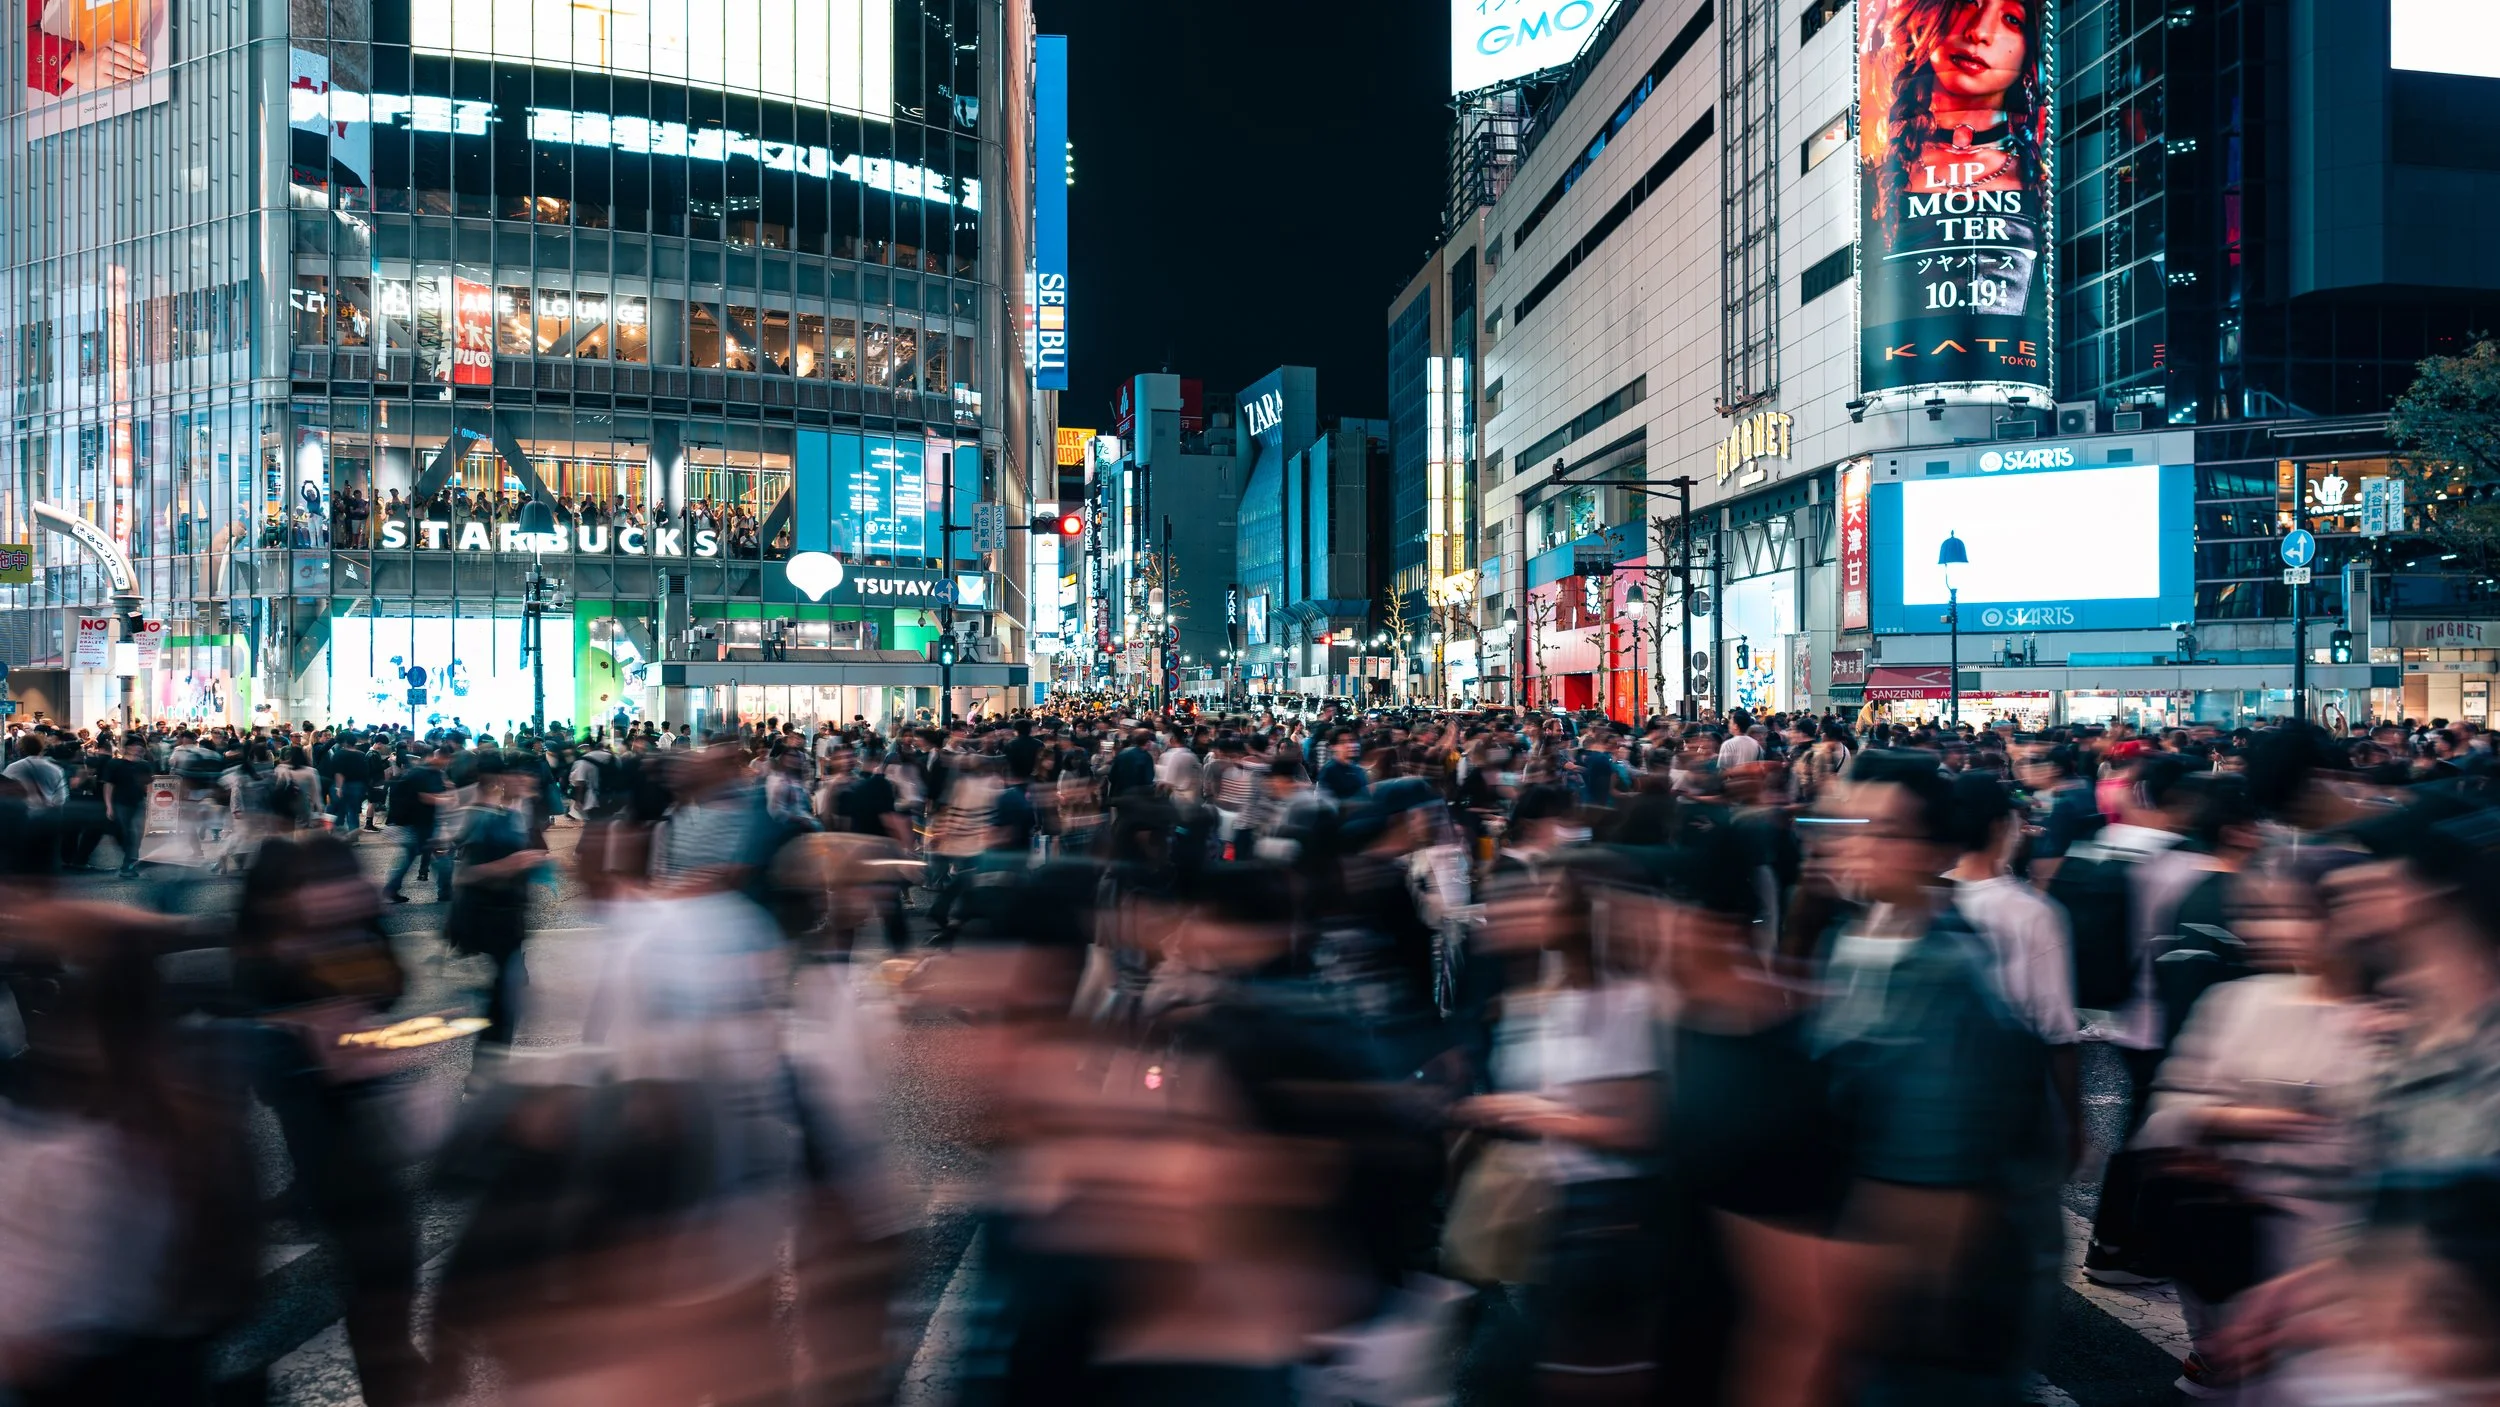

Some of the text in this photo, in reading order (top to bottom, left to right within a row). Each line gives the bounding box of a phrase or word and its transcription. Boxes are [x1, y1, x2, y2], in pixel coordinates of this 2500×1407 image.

[1476, 0, 1595, 56] GMO
[84, 102, 108, 114] CHANL.COM
[1924, 162, 1986, 189] LIP
[1908, 188, 2022, 219] MONS
[1936, 218, 2010, 242] TER
[1916, 254, 2016, 276] ツヤバース
[1925, 278, 1997, 310] 10.19
[540, 297, 646, 324] LOUNGE
[1039, 273, 1065, 370] SEIBU
[1885, 338, 2038, 362] KATE
[2000, 355, 2038, 369] TOKYO
[1244, 388, 1283, 437] ZARA
[1716, 411, 1795, 486] MAGNET
[2371, 482, 2383, 532] 渋谷駅前
[2392, 482, 2401, 529] スクランブル式
[381, 520, 719, 557] STARBUCKS
[980, 506, 990, 549] 渋谷駅前
[995, 507, 1004, 548] スクランブル式
[1084, 498, 1094, 552] KARAOKE
[76, 524, 126, 587] 渋谷センター街
[1846, 500, 1863, 617] 天津甘栗
[1227, 590, 1237, 624] ZARA
[81, 619, 107, 631] NO
[2426, 622, 2482, 641] MAGNET
[1251, 664, 1267, 677] ZARA
[1834, 659, 1863, 675] 天津甘栗
[158, 700, 210, 719] Andod
[1872, 690, 1924, 699] SANZENRI
